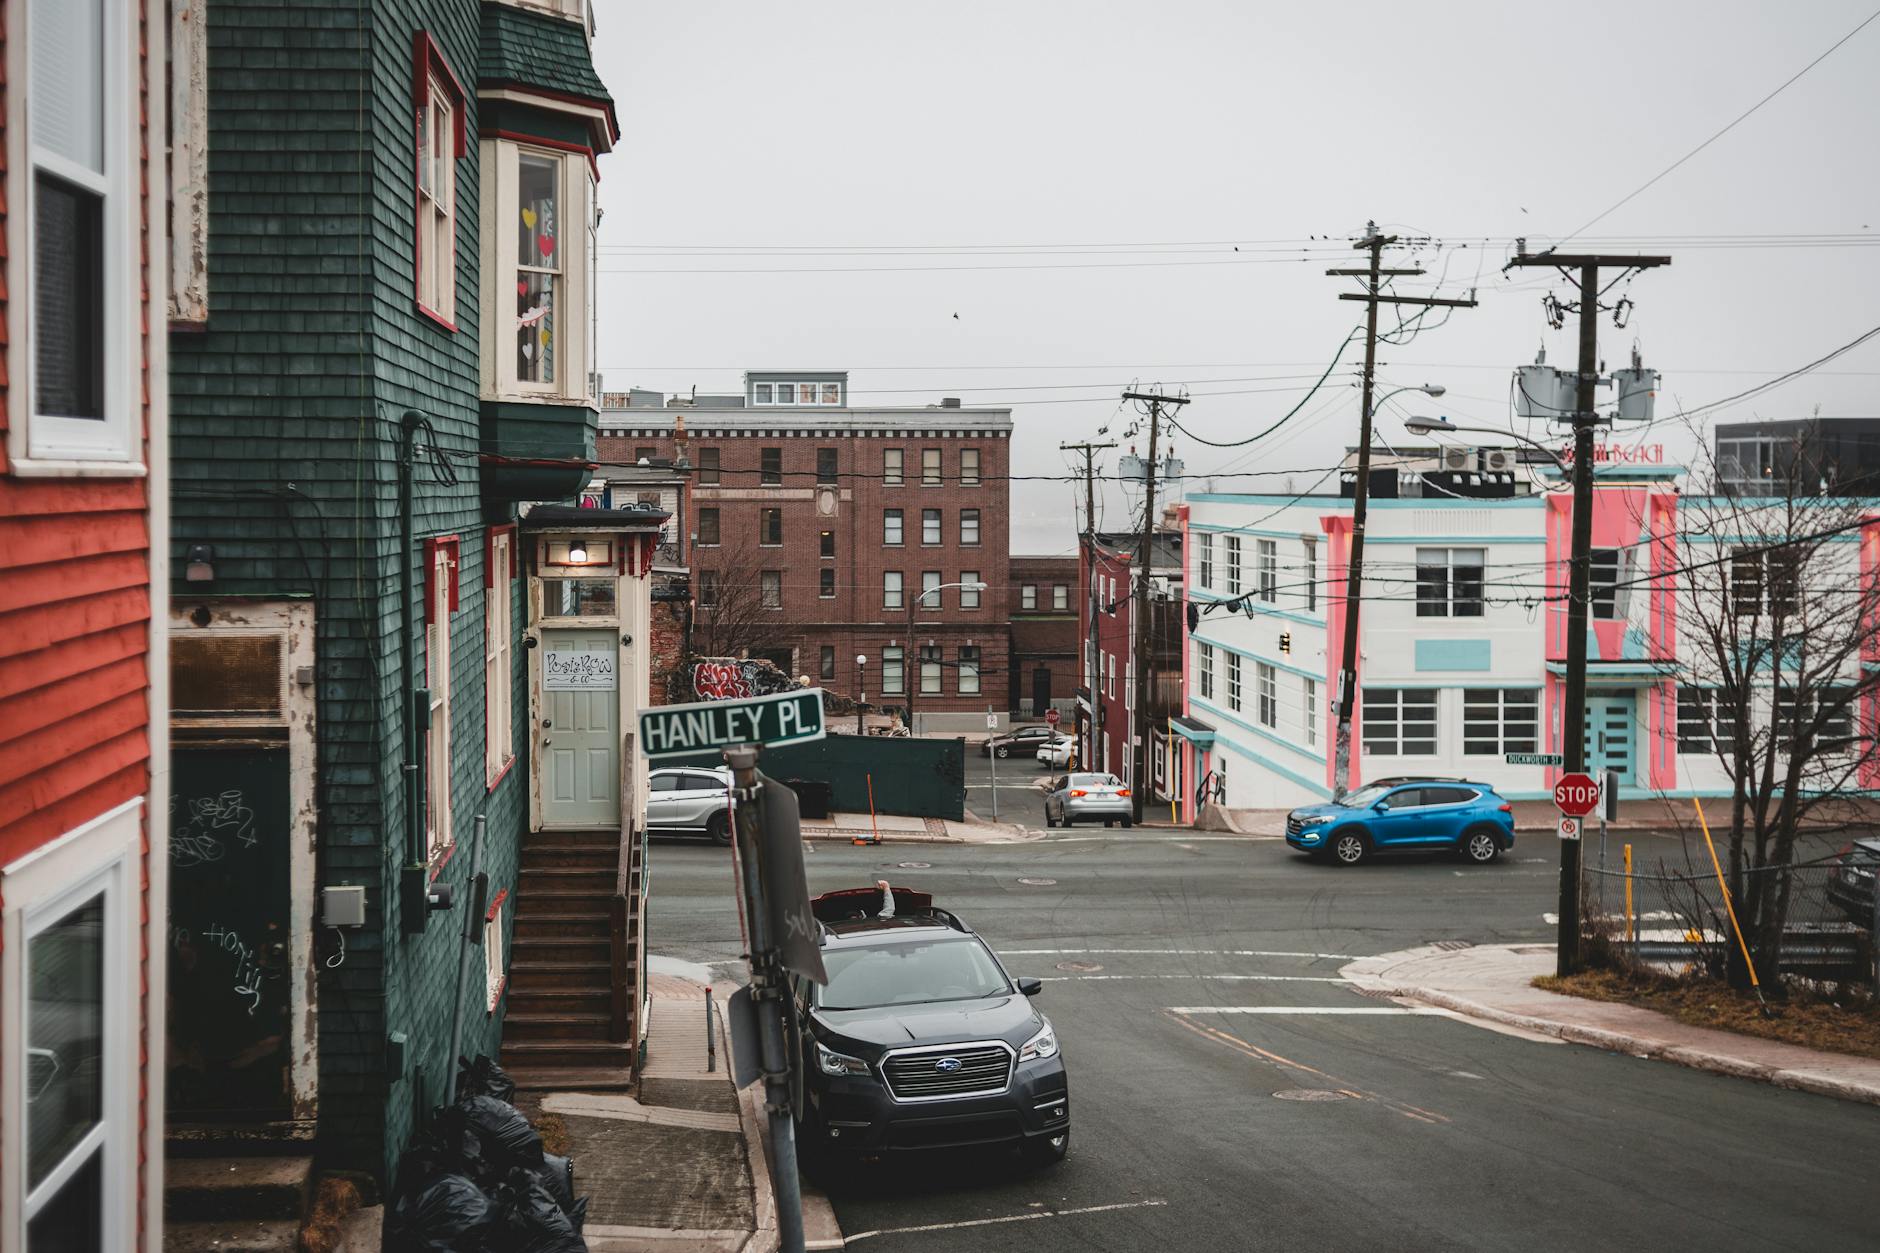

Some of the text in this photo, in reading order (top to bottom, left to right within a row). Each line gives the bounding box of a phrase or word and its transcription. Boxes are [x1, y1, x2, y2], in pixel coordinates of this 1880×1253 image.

[1613, 443, 1663, 464] BEACH
[645, 699, 818, 750] HANLEY PL.
[1508, 754, 1548, 765] DUCKWORTH
[1556, 786, 1598, 803] STOP
